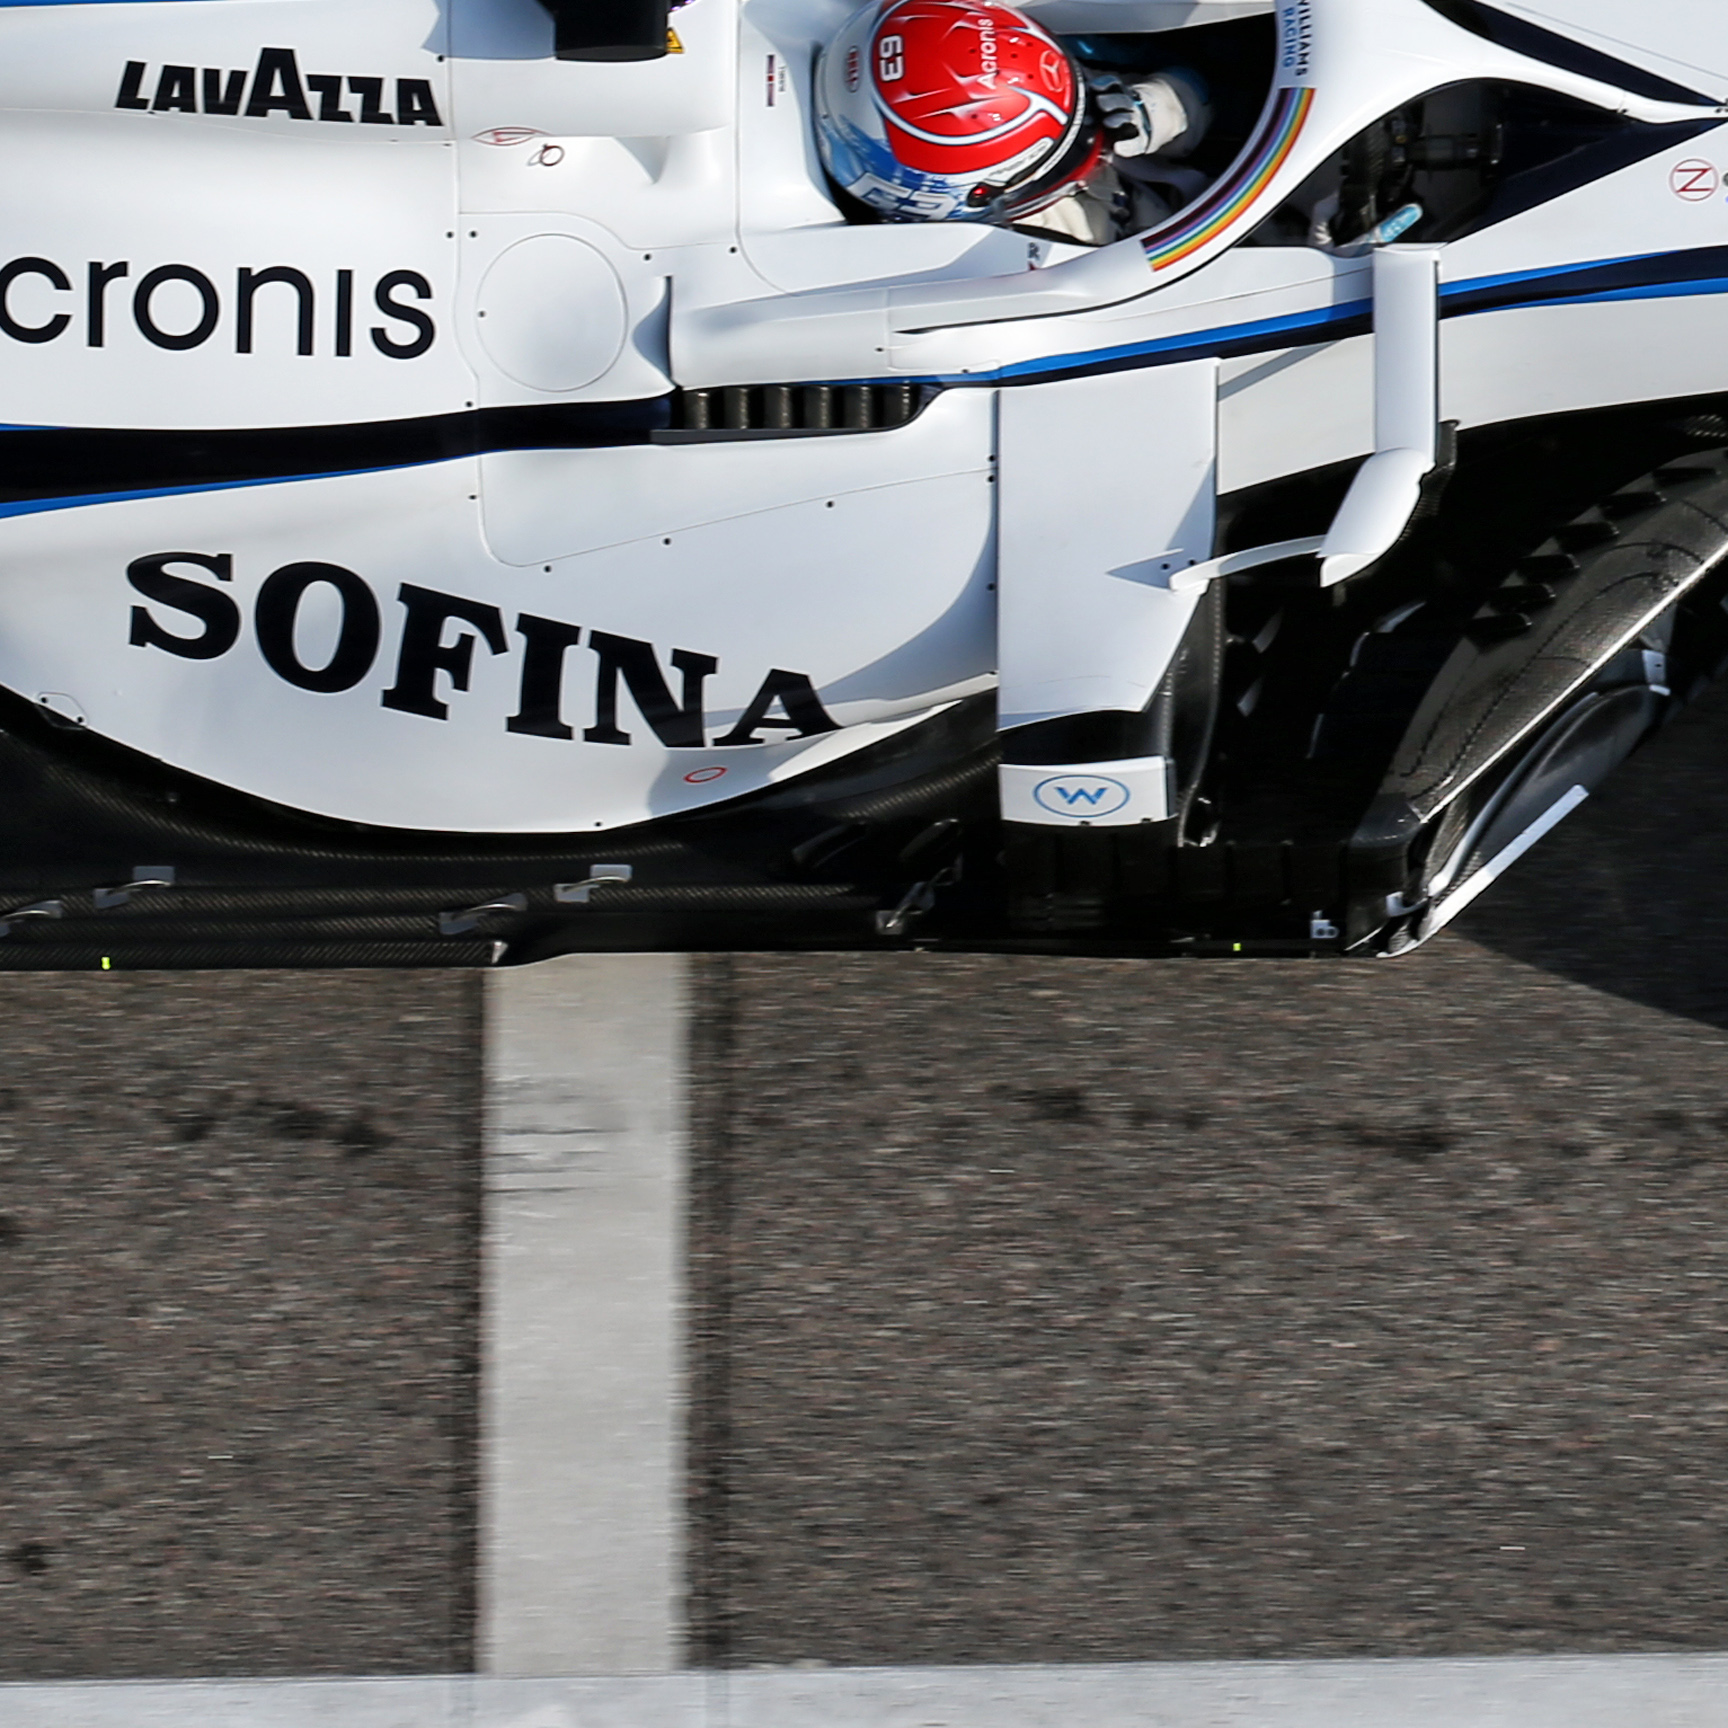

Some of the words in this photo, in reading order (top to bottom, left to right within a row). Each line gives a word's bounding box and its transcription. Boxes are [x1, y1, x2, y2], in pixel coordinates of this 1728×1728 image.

[878, 34, 904, 82] 63
[976, 18, 998, 89] Acronis
[1282, 7, 1296, 68] RACING
[115, 48, 444, 127] LAVAZZA
[126, 552, 844, 750] SOFINA
